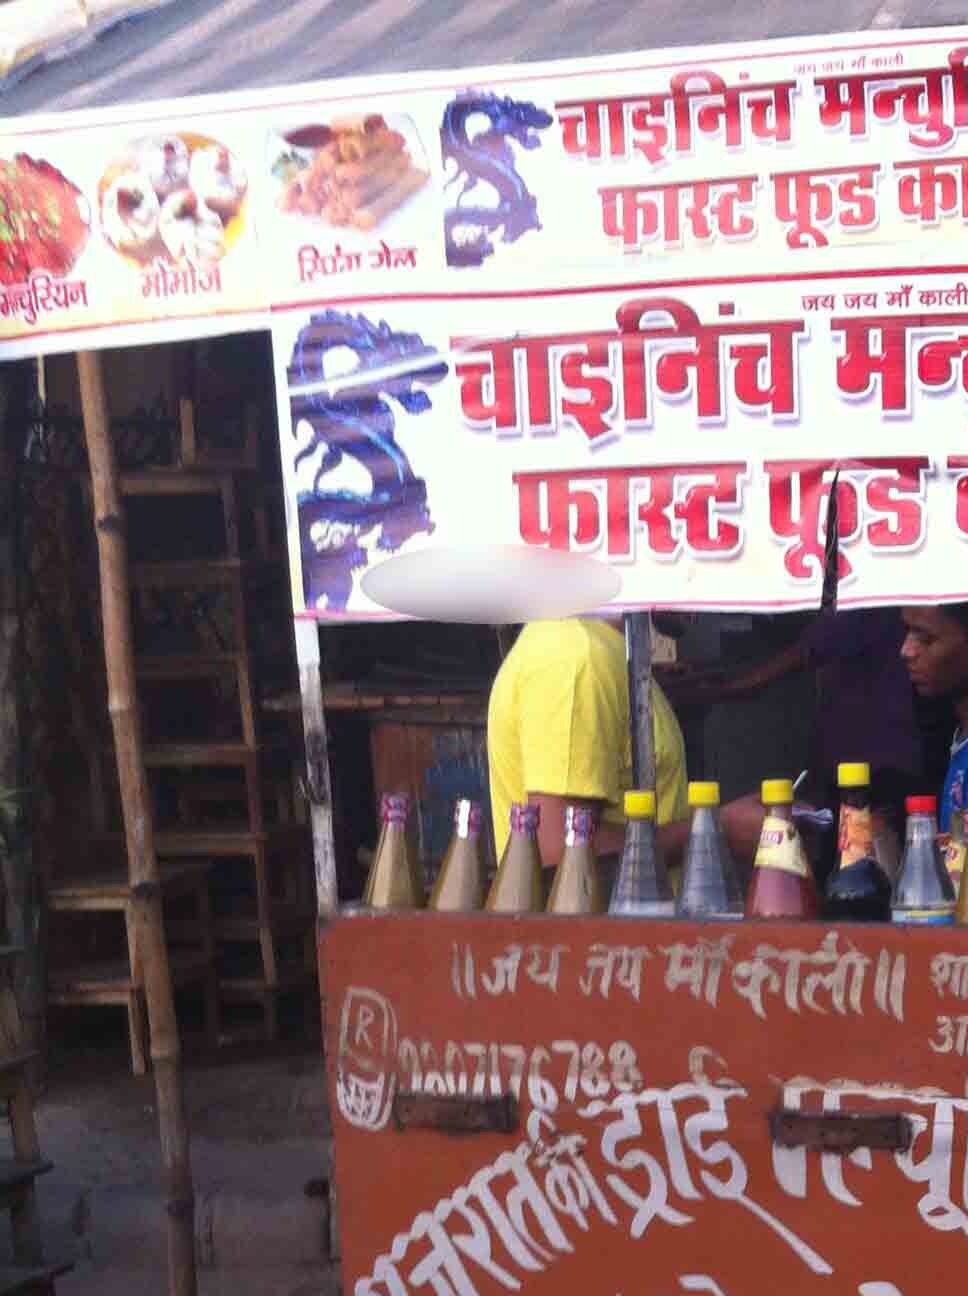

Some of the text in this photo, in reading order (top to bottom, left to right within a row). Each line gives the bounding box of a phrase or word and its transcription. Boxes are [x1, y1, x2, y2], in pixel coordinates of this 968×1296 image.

[597, 173, 759, 247] फास्ट
[769, 163, 881, 250] फूड
[801, 294, 835, 312] जय
[843, 292, 878, 310] जय
[917, 282, 968, 307] काली
[512, 460, 747, 556] फास्ट
[763, 457, 931, 580] फूड
